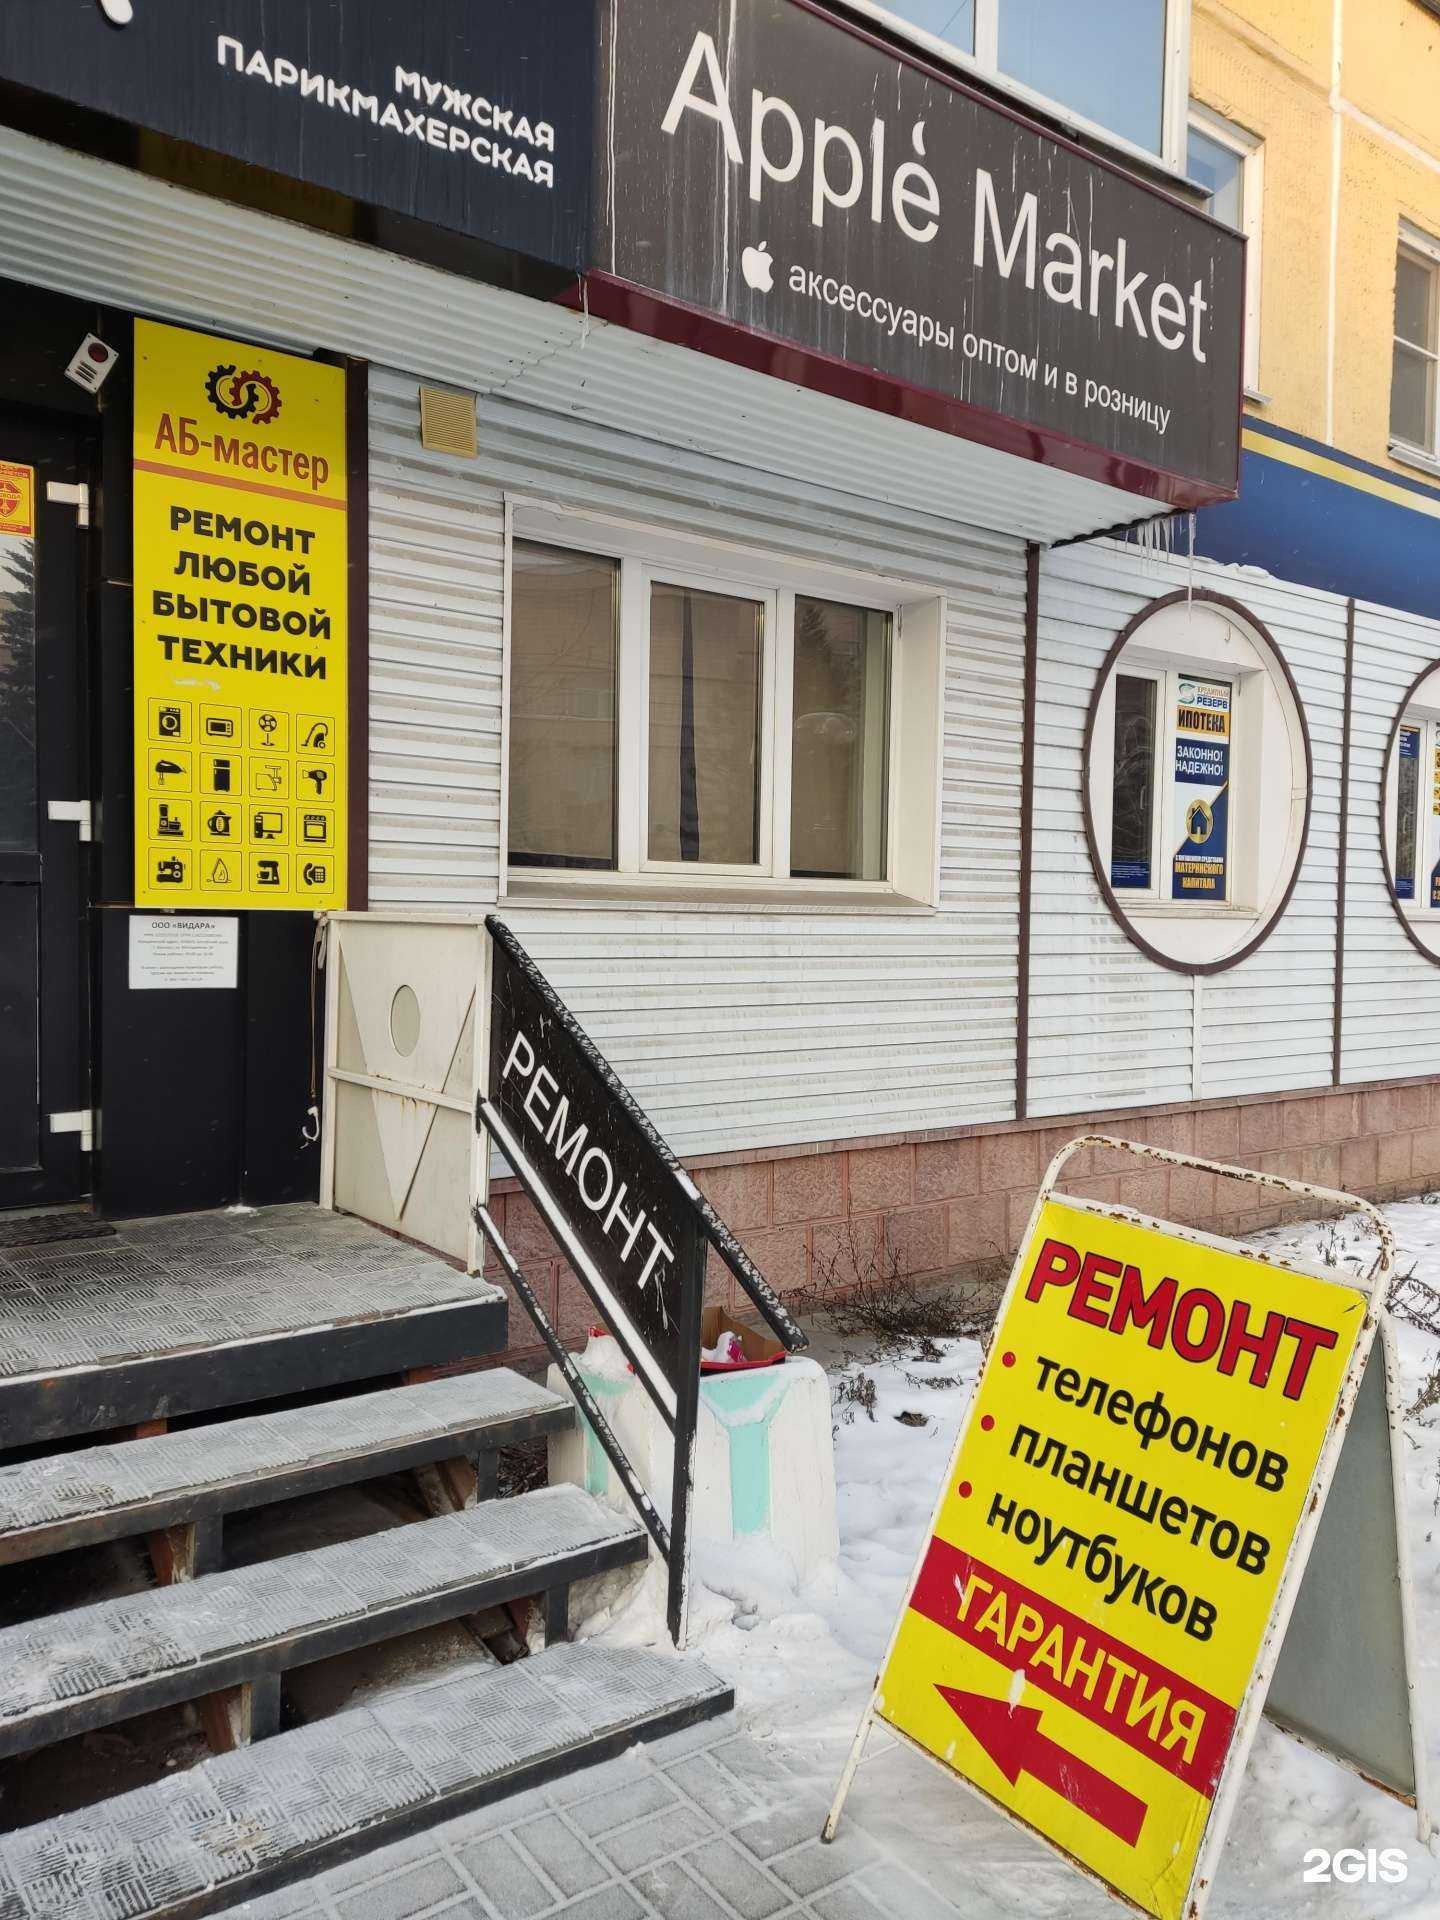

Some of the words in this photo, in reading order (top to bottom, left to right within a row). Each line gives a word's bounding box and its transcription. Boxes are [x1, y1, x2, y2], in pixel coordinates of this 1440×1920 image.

[217, 35, 554, 188] ПАРИКМАХЕРСКАЯ
[395, 65, 555, 152] МУЖСКАЯ
[661, 31, 940, 244] Apple
[973, 168, 1208, 364] Market
[789, 264, 955, 352] аксессуары
[963, 330, 1038, 376] оптом
[1044, 363, 1058, 390] и
[1066, 370, 1078, 396] в
[1085, 375, 1171, 436] розницу
[154, 413, 329, 490] АБ-мастер
[170, 505, 315, 554] РЕМОНТ
[174, 550, 310, 595] ЛЮБОЙ
[152, 590, 331, 640] БЫТОВОЙ
[157, 634, 326, 680] ТЕХНИКИ
[1178, 708, 1226, 733] ИПОТЕКА
[1196, 696, 1228, 709] РЕЗЕРВ
[1175, 759, 1224, 776] НАДЕЖНО!
[1177, 745, 1223, 762] ЗАКОННО!
[151, 921, 170, 929] ООО
[502, 1030, 675, 1290] РЕМОНТ
[1024, 1238, 1339, 1401] РЕМОНТ
[1036, 1355, 1289, 1493] телефонов
[1008, 1424, 1271, 1576] планшетов
[986, 1493, 1219, 1642] ноутбуков
[956, 1573, 1207, 1766] ГАРАНТИЯ
